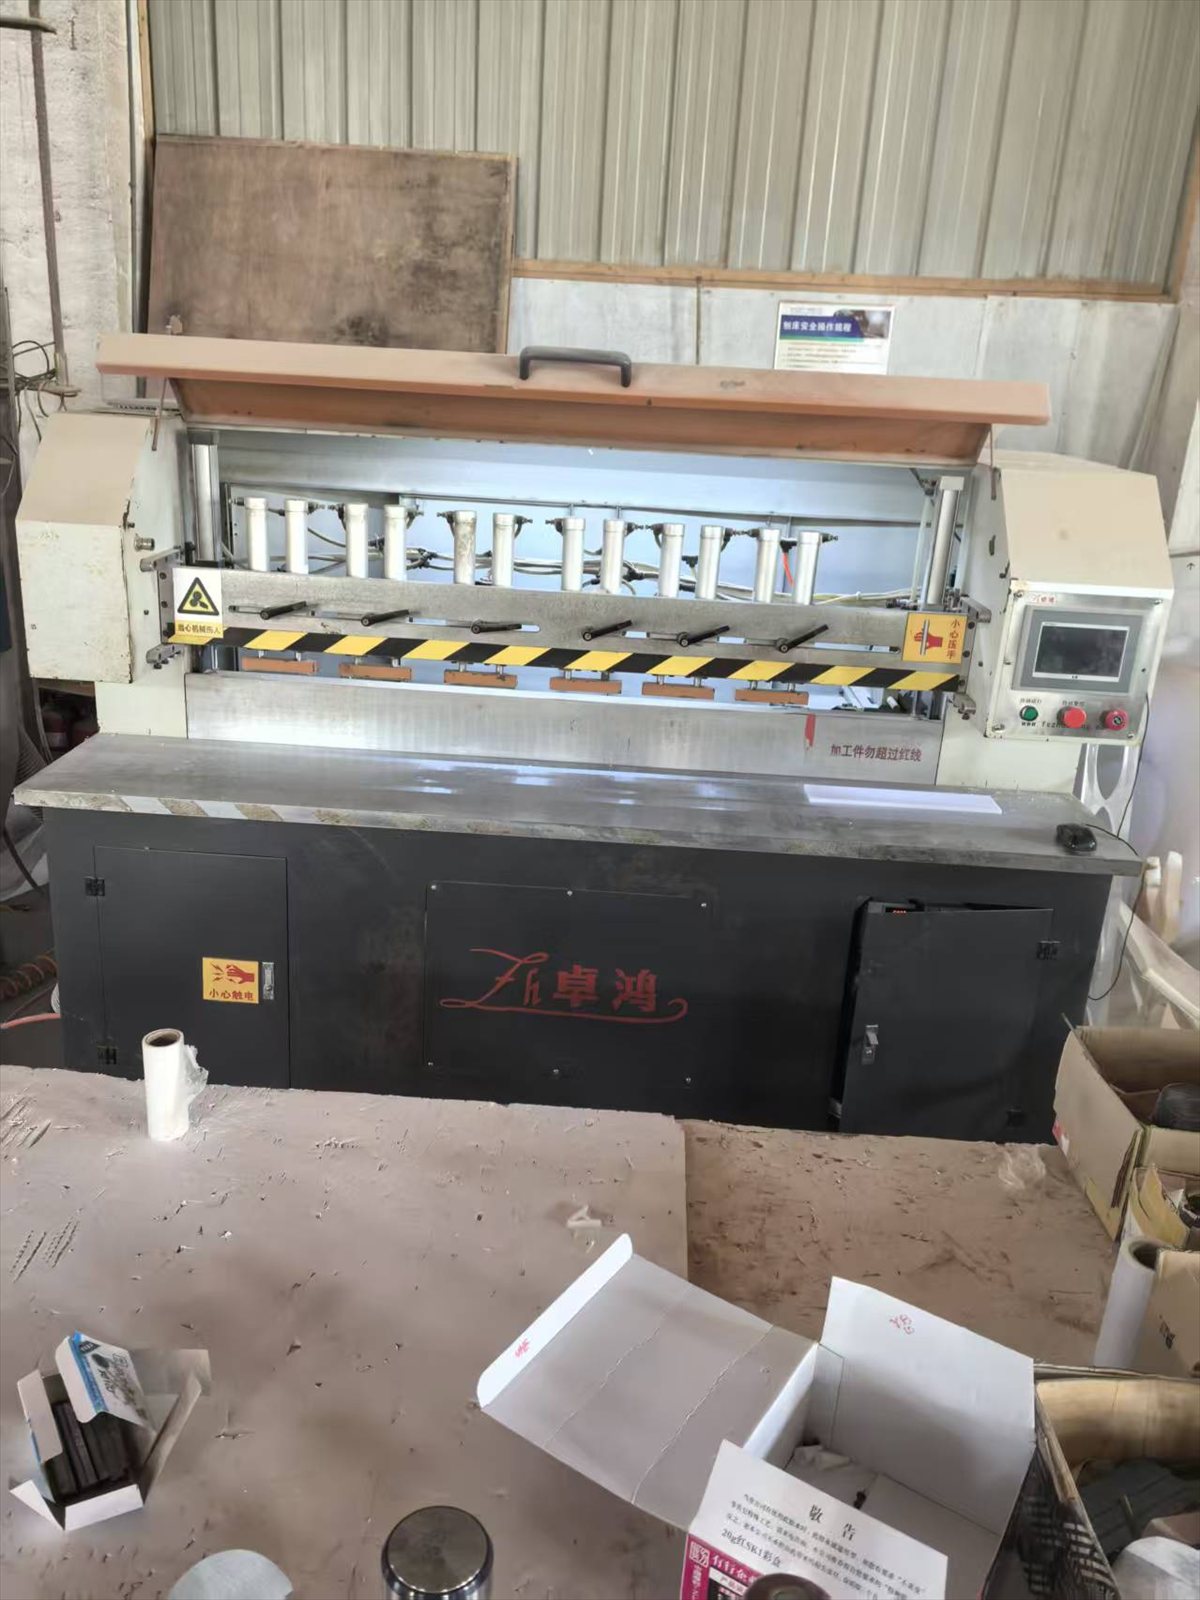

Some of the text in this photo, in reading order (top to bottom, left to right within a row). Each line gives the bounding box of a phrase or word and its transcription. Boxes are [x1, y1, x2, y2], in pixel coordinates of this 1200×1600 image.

[178, 623, 221, 635] 当心机械伤人
[831, 743, 922, 762] 加工件勿超过红线
[209, 988, 254, 1001] 小心触电
[552, 963, 658, 1012] 卓鸿
